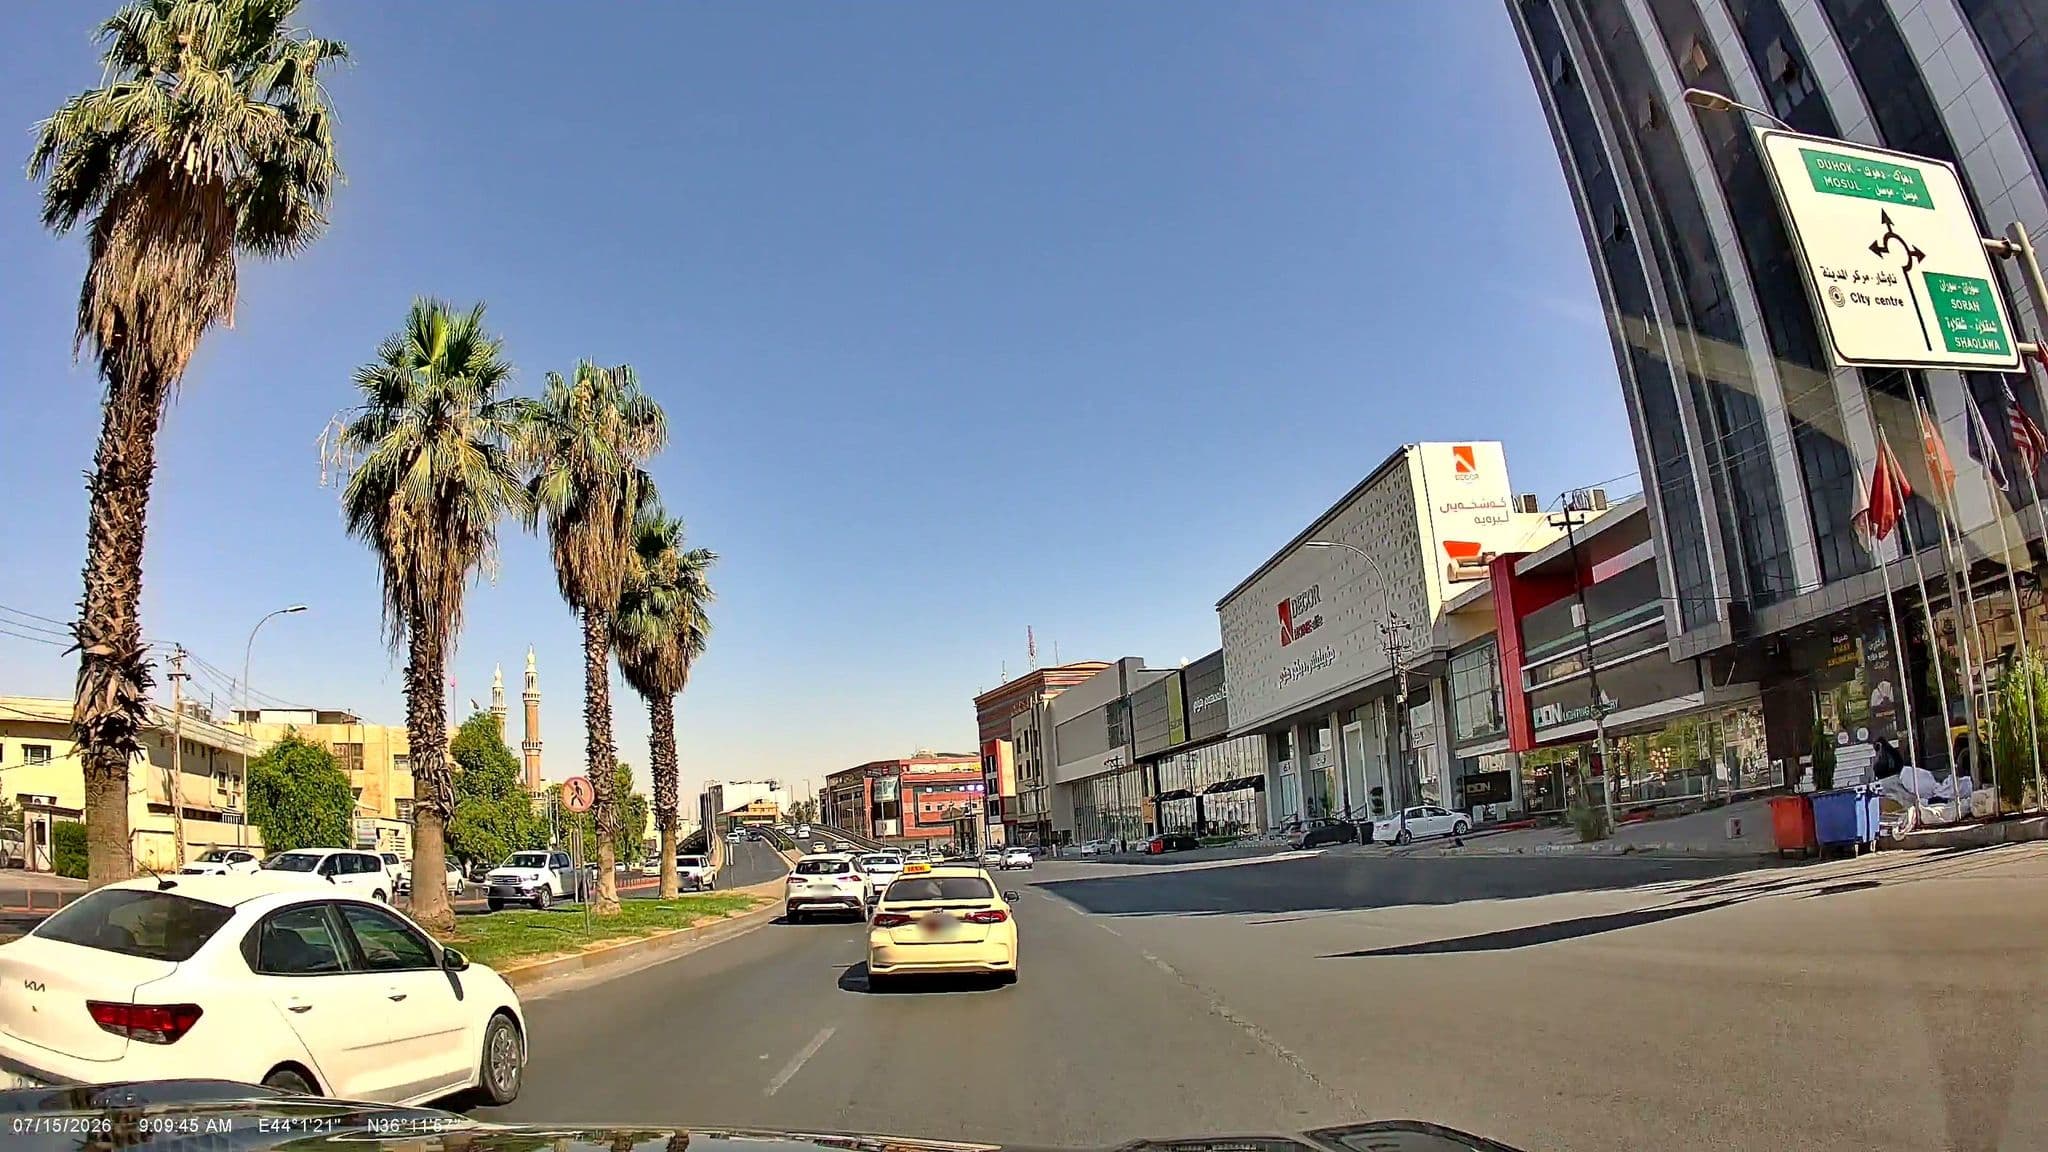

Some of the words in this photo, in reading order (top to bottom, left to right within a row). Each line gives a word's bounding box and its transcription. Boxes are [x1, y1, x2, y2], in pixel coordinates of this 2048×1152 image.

[1816, 158, 1855, 174] DUHOK
[1823, 175, 1862, 191] MOSUL
[1819, 265, 1849, 283] المدينة
[1850, 292, 1871, 307] City
[1874, 296, 1905, 308] centre
[1950, 298, 1981, 313] SORAN
[1954, 336, 2001, 352] SHAQLAWA
[1291, 584, 1321, 618] DECOR
